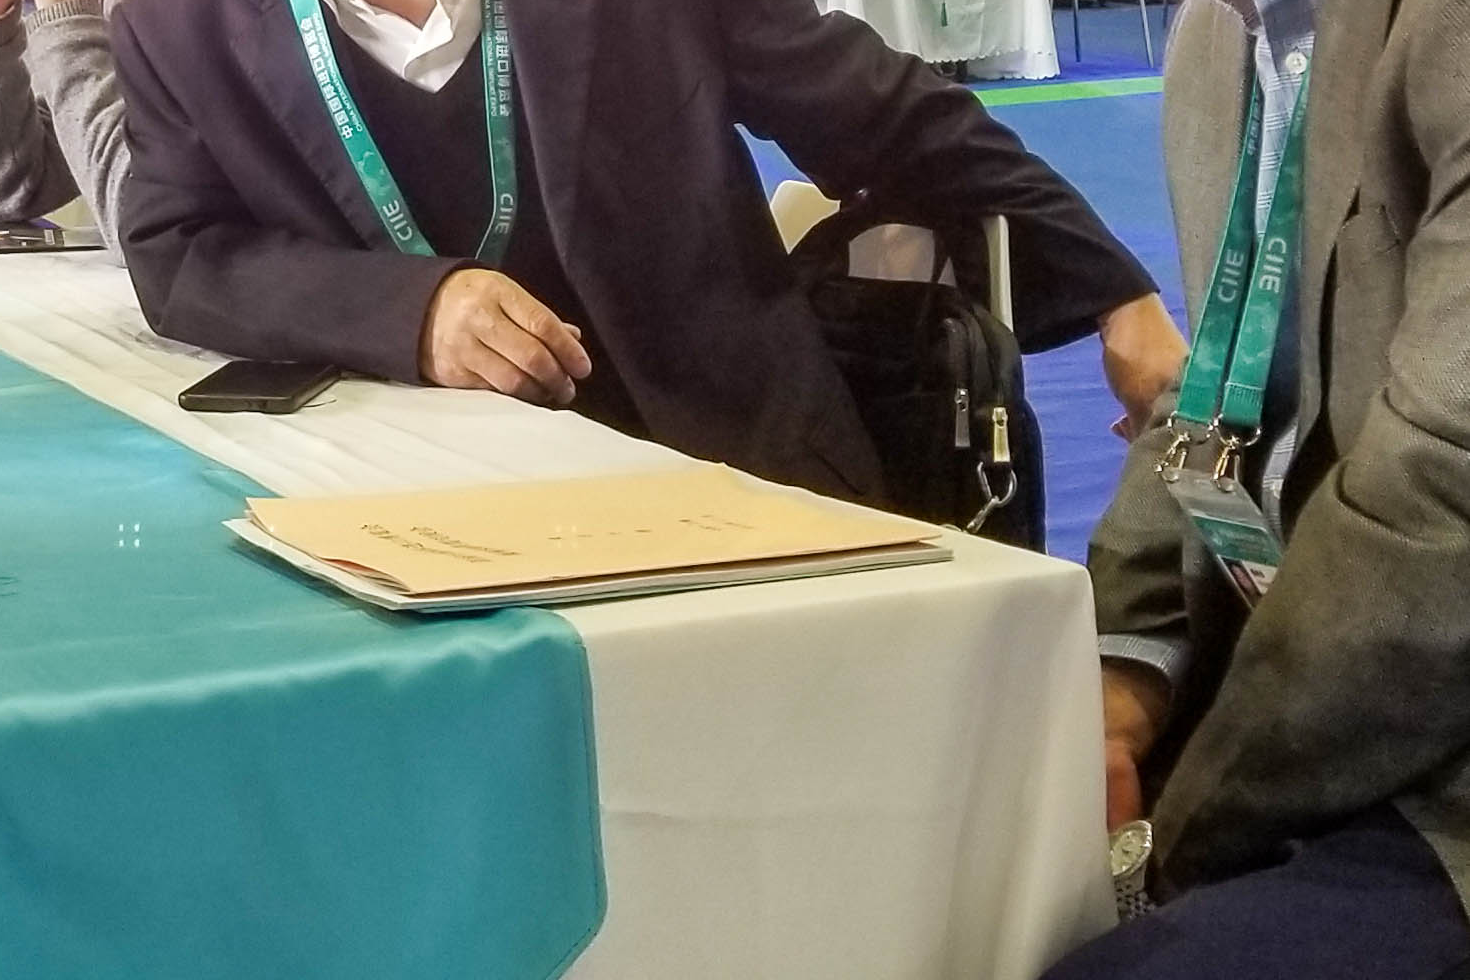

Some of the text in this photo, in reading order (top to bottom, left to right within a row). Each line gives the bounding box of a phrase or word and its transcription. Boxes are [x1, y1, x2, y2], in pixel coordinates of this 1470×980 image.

[382, 199, 413, 241] CIIE
[494, 193, 514, 235] CIIE
[1217, 248, 1244, 303] CIIE
[1259, 237, 1287, 294] CIIE
